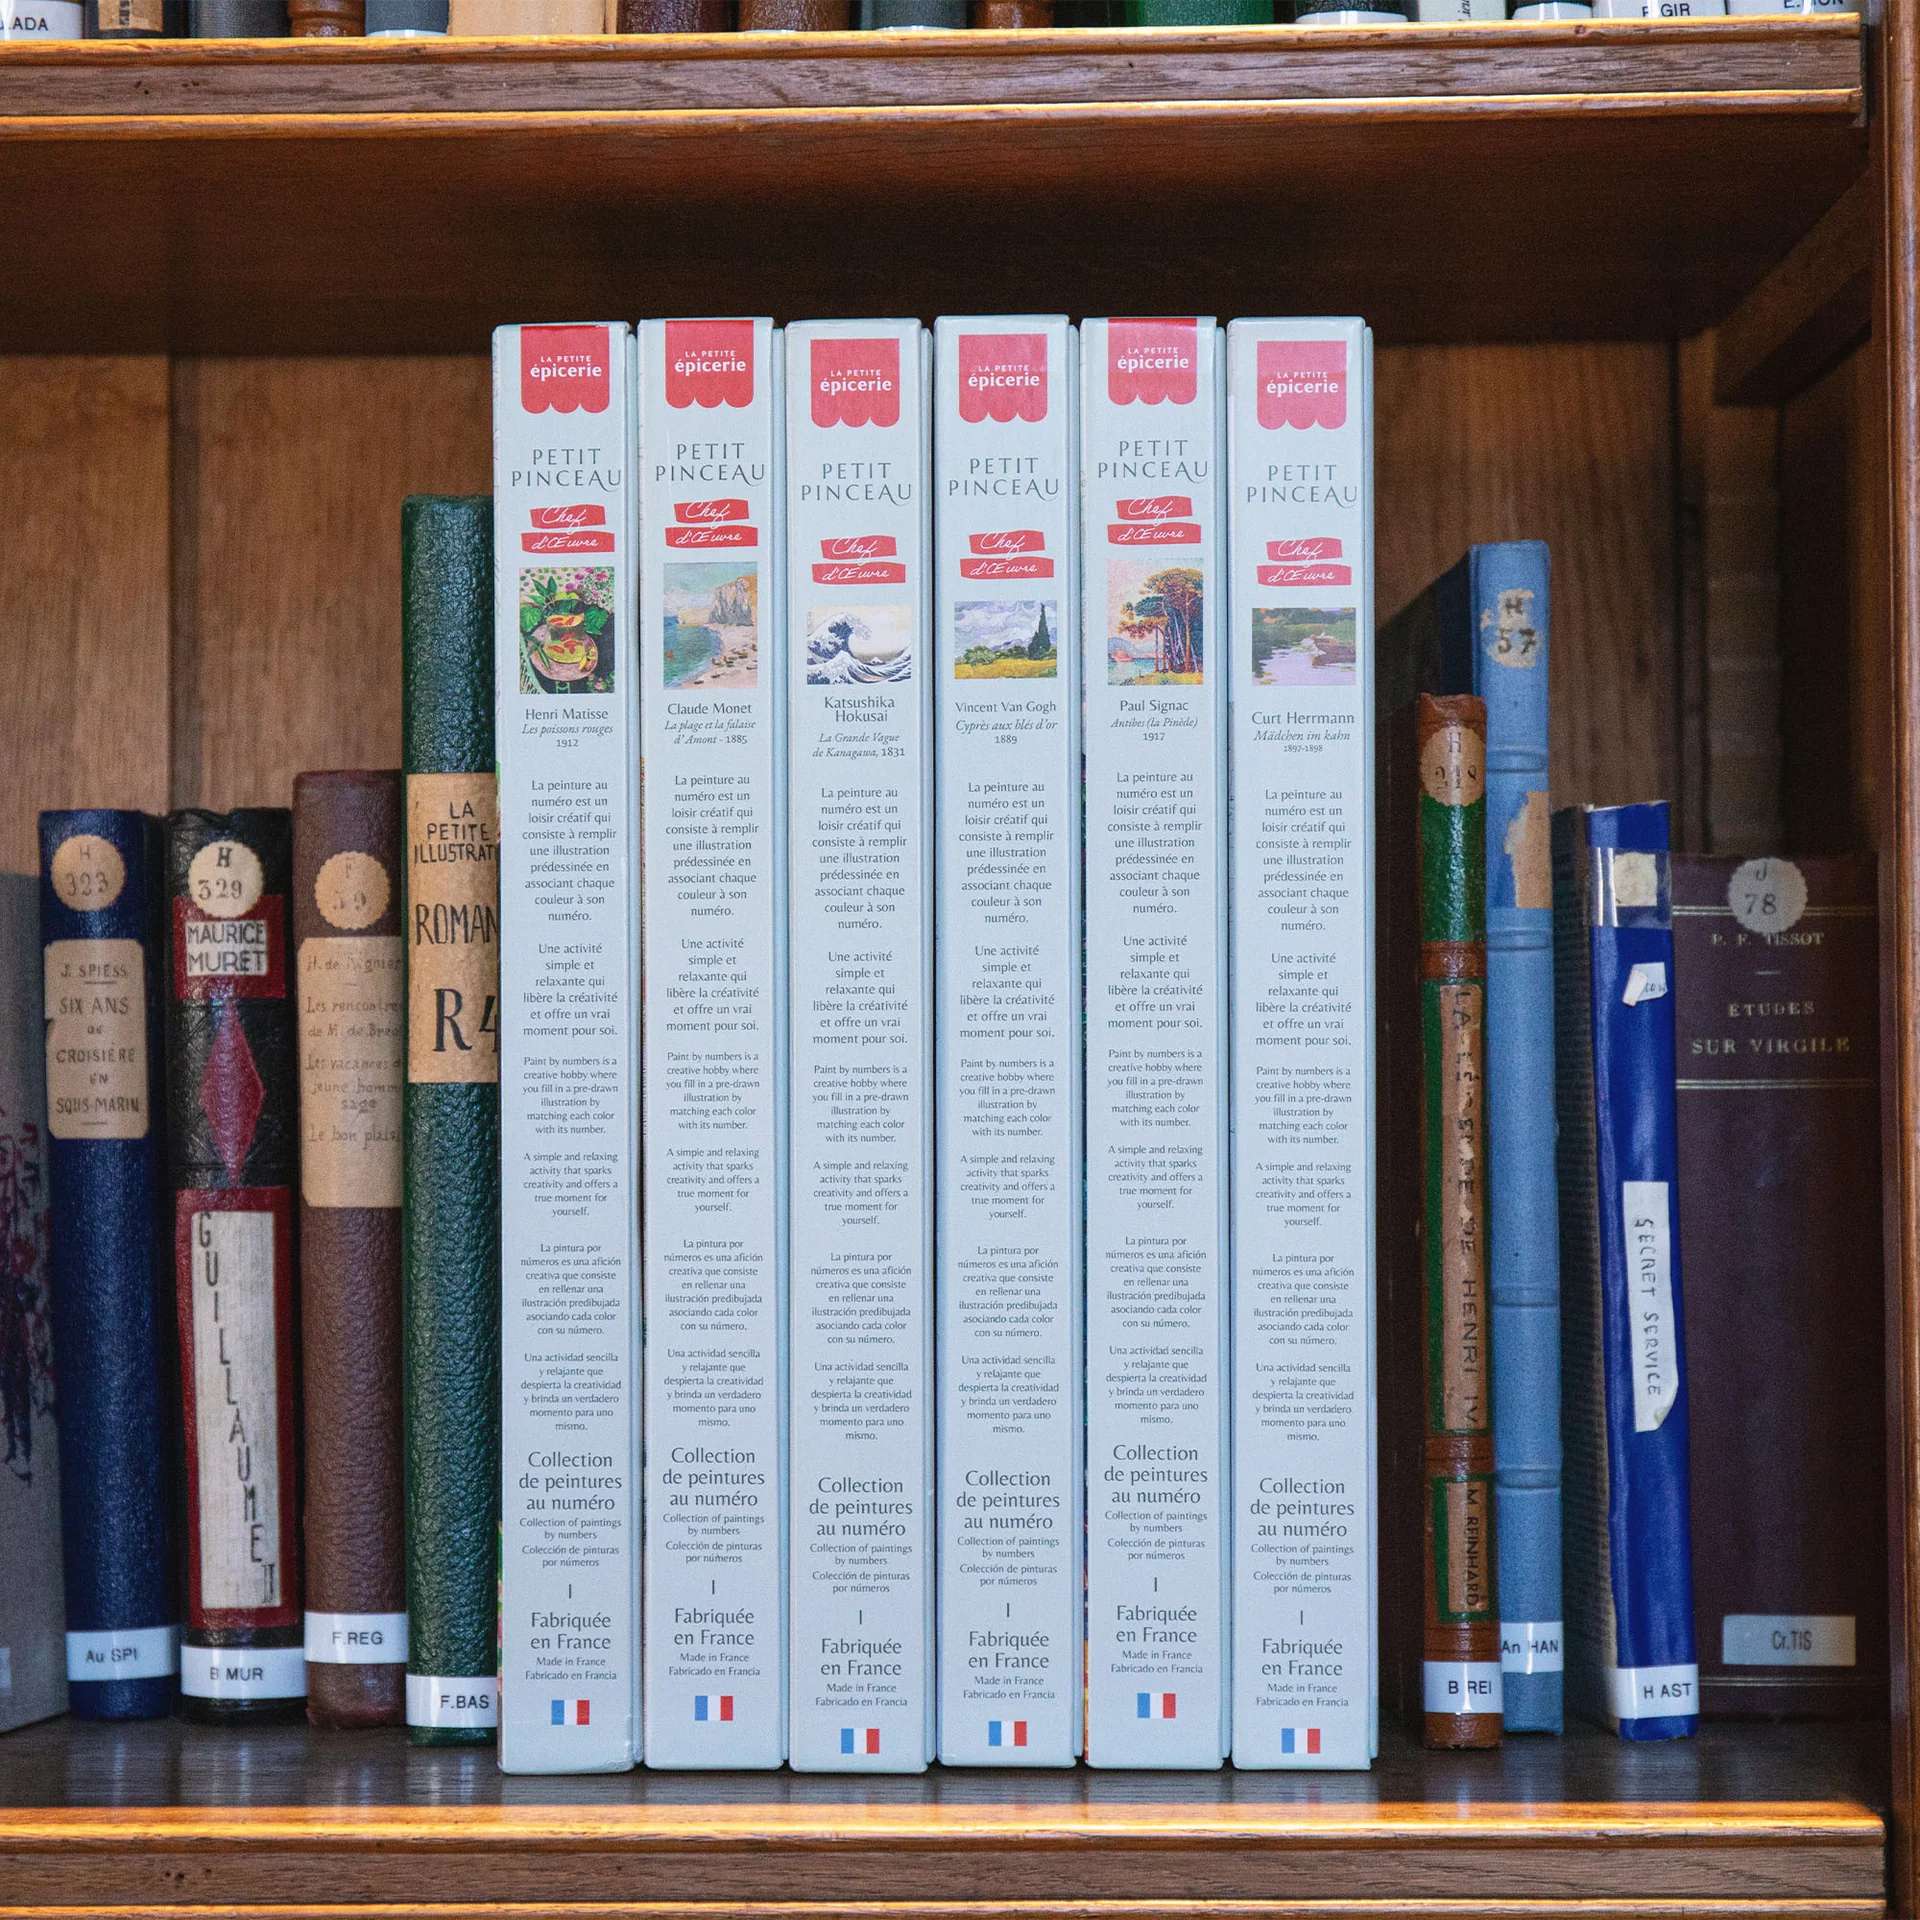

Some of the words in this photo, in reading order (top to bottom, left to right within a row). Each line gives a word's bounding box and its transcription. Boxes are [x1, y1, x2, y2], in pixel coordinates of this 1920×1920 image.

[539, 354, 553, 365] LA
[555, 353, 593, 364] PETITE
[684, 349, 697, 359] LA
[700, 348, 737, 359] PETITE
[1127, 345, 1140, 356] LA
[1143, 344, 1179, 356] PETITE
[530, 362, 603, 382] épicerie
[674, 357, 747, 377] épicerie
[977, 363, 991, 374] LA
[993, 362, 1030, 373] PETITE
[1117, 353, 1189, 373] épicerie
[829, 368, 843, 379] LA
[845, 367, 882, 378] PETITE
[967, 370, 1040, 391] épicerie
[1276, 369, 1290, 380] LA
[1292, 369, 1328, 380] PETITE
[819, 376, 892, 397] épicerie
[1266, 378, 1339, 398] épicerie
[532, 447, 601, 466] PETIT
[676, 442, 745, 461] PETIT
[1119, 439, 1189, 457] PETIT
[655, 463, 765, 487] PINCEAU
[822, 462, 892, 480] PETIT
[969, 457, 1039, 475] PETIT
[1097, 460, 1208, 484] PINCEAU
[1268, 463, 1337, 482] PETIT
[511, 469, 622, 493] PINCEAU
[949, 478, 1059, 501] PINCEAU
[801, 483, 912, 506] PINCEAU
[1247, 485, 1358, 509] PINCEAU
[541, 505, 588, 533] Chef
[685, 500, 730, 528] Chef
[1127, 498, 1173, 524] Chef
[831, 536, 877, 564] Chef
[979, 532, 1024, 559] Chef
[1278, 539, 1322, 566] Chef
[667, 702, 709, 716] Claude
[712, 702, 753, 715] Monet
[824, 695, 896, 709] Katsushika
[954, 701, 998, 713] Vincent
[1000, 701, 1023, 713] Van
[1025, 700, 1057, 715] Gogh
[1119, 699, 1145, 712] Paul
[1149, 699, 1189, 715] Signac
[525, 708, 558, 721] Henri
[562, 707, 609, 720] Matisse
[835, 707, 888, 723] Hokusai
[1109, 716, 1145, 729] Antibes
[1146, 716, 1161, 730] (la
[1162, 716, 1199, 729] Pinède)
[1251, 711, 1282, 725] Curt
[1286, 711, 1355, 725] Herrmann
[521, 723, 541, 738] Les
[539, 723, 581, 738] poissons
[581, 725, 614, 738] rouges
[663, 719, 678, 731] La
[677, 719, 704, 734] plage
[704, 721, 714, 730] et
[714, 718, 725, 729] la
[723, 718, 757, 733] falaise
[955, 719, 991, 735] Cyprès
[991, 722, 1013, 731] aux
[1014, 718, 1034, 731] blés
[1035, 717, 1059, 730] d'or
[1252, 729, 1304, 742] Mädchen
[1306, 730, 1321, 741] im
[1323, 729, 1351, 742] kahn
[555, 738, 580, 749] 1912
[724, 734, 748, 745] 1885
[818, 732, 833, 743] La
[834, 731, 871, 743] Grande
[872, 731, 901, 746] Vague
[994, 734, 1018, 745] 1889
[1142, 731, 1166, 742] 1917
[811, 746, 824, 758] de
[825, 747, 879, 761] Kanagawa,
[881, 745, 905, 758] 1831
[531, 779, 545, 791] La
[547, 779, 593, 793] peinture
[594, 781, 608, 791] au
[449, 799, 475, 819] LA
[426, 822, 490, 842] PETITE
[215, 847, 233, 869] H
[414, 843, 497, 865] ILLUSTRAT
[197, 879, 244, 901] 329
[1744, 892, 1778, 916] 78
[186, 923, 266, 948] MAURICE
[188, 949, 266, 974] MURET
[58, 996, 85, 1015] SIX
[91, 996, 130, 1015] ANS
[432, 986, 473, 1053] R
[1690, 1038, 1738, 1056] SUR
[1748, 1037, 1852, 1055] VIRGILE
[1634, 1216, 1658, 1299] SECRET
[1461, 1277, 1480, 1376] HENRI
[1642, 1309, 1663, 1400] SERVICE
[1463, 1380, 1481, 1425] IV
[1259, 1477, 1345, 1495] Collection
[1250, 1498, 1271, 1515] de
[1276, 1499, 1355, 1518] peintures
[1257, 1524, 1277, 1537] au
[1282, 1520, 1348, 1537] numéro
[674, 1607, 755, 1626] Fabriquée
[332, 1631, 384, 1647] F.REG
[673, 1633, 694, 1646] en
[700, 1628, 755, 1646] France
[1501, 1637, 1521, 1656] An
[85, 1648, 105, 1664] Au
[110, 1647, 138, 1664] SPI
[209, 1666, 220, 1681] B
[225, 1666, 264, 1682] MUR
[1448, 1679, 1459, 1695] B
[1466, 1680, 1493, 1696] REI
[1643, 1684, 1655, 1700] H
[1659, 1681, 1693, 1701] AST
[440, 1693, 491, 1710] F.BAS
